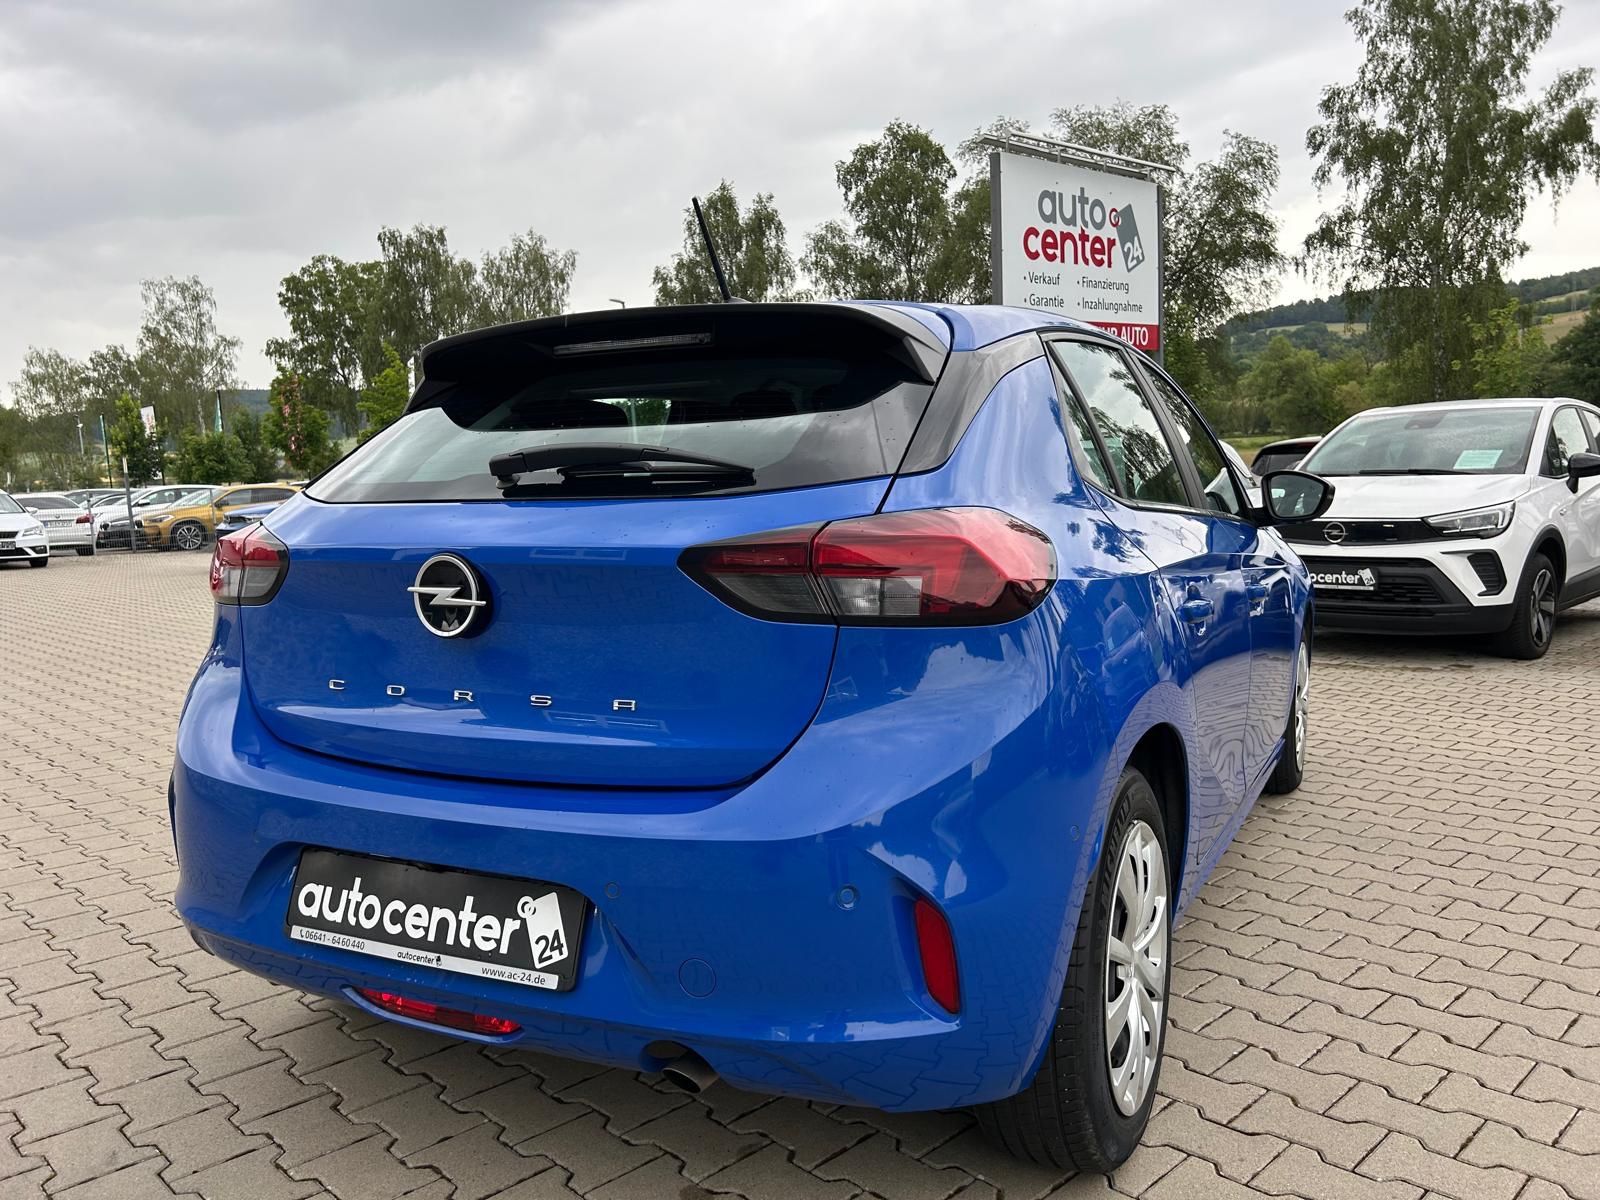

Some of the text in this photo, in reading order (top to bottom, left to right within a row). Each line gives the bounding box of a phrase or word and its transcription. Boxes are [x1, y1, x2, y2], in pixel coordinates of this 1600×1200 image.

[1038, 187, 1106, 230] auto
[1023, 226, 1116, 268] center
[1123, 236, 1144, 270] 24
[1028, 271, 1061, 286] Verkauf
[1081, 276, 1130, 294] Finanzierung
[1029, 293, 1065, 308] Garantie
[1082, 297, 1143, 314] Inzahlungnahme
[1120, 326, 1149, 346] AUTO
[328, 679, 636, 711] CORSA
[298, 877, 521, 954] autocenter
[535, 929, 564, 964] 24
[397, 950, 435, 965] autocenter
[481, 967, 546, 985] www.ac-24.de
